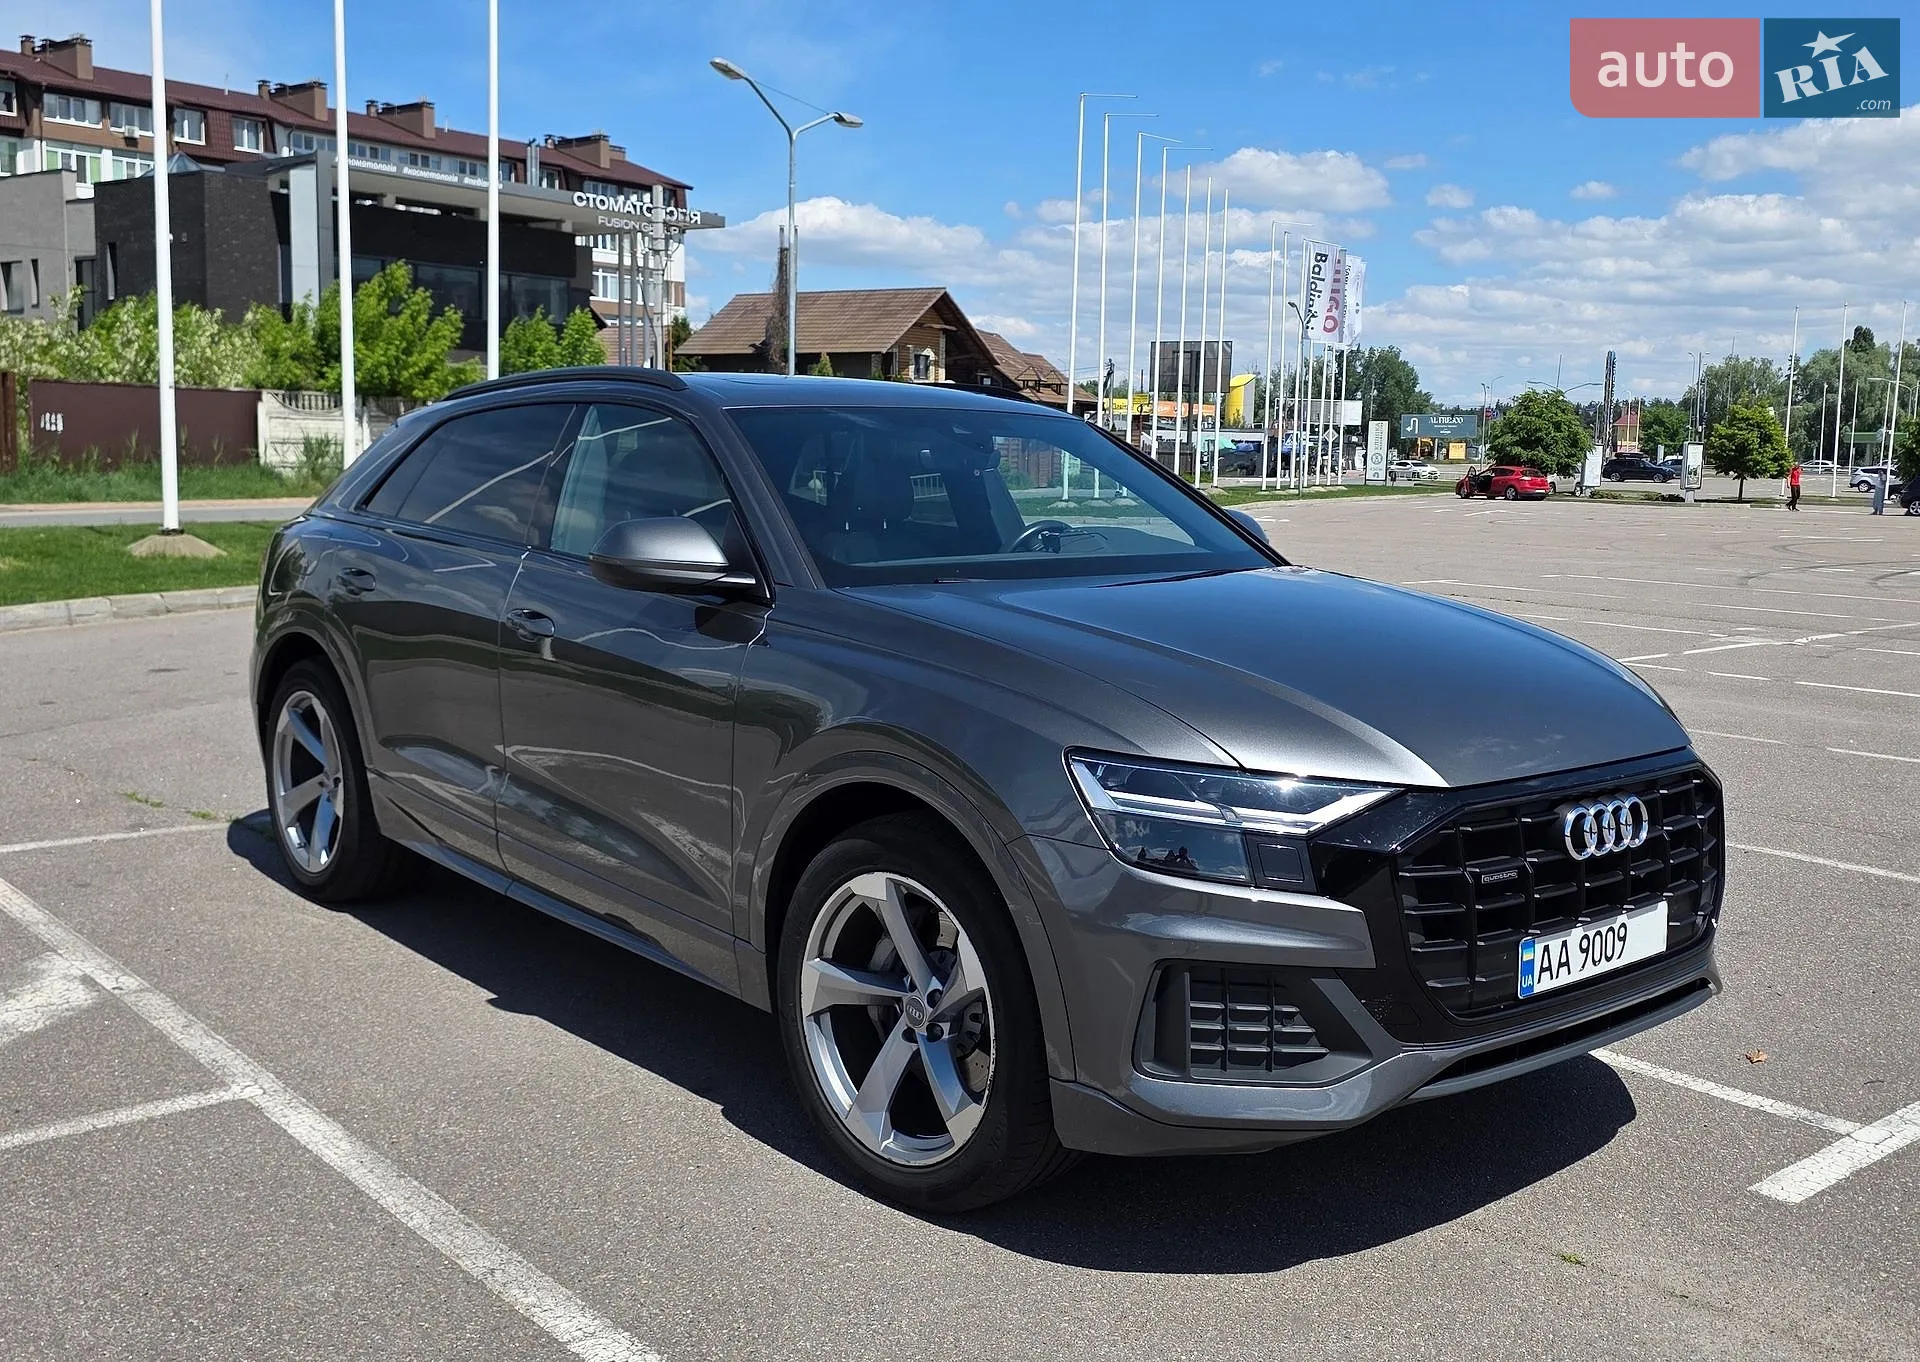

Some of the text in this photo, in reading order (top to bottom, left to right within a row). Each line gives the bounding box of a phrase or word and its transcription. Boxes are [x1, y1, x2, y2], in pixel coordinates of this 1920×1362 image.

[573, 191, 701, 225] СТОМАТООГІЯ
[598, 215, 640, 230] FUSION
[1578, 922, 1628, 972] 9009
[1521, 974, 1534, 987] UA
